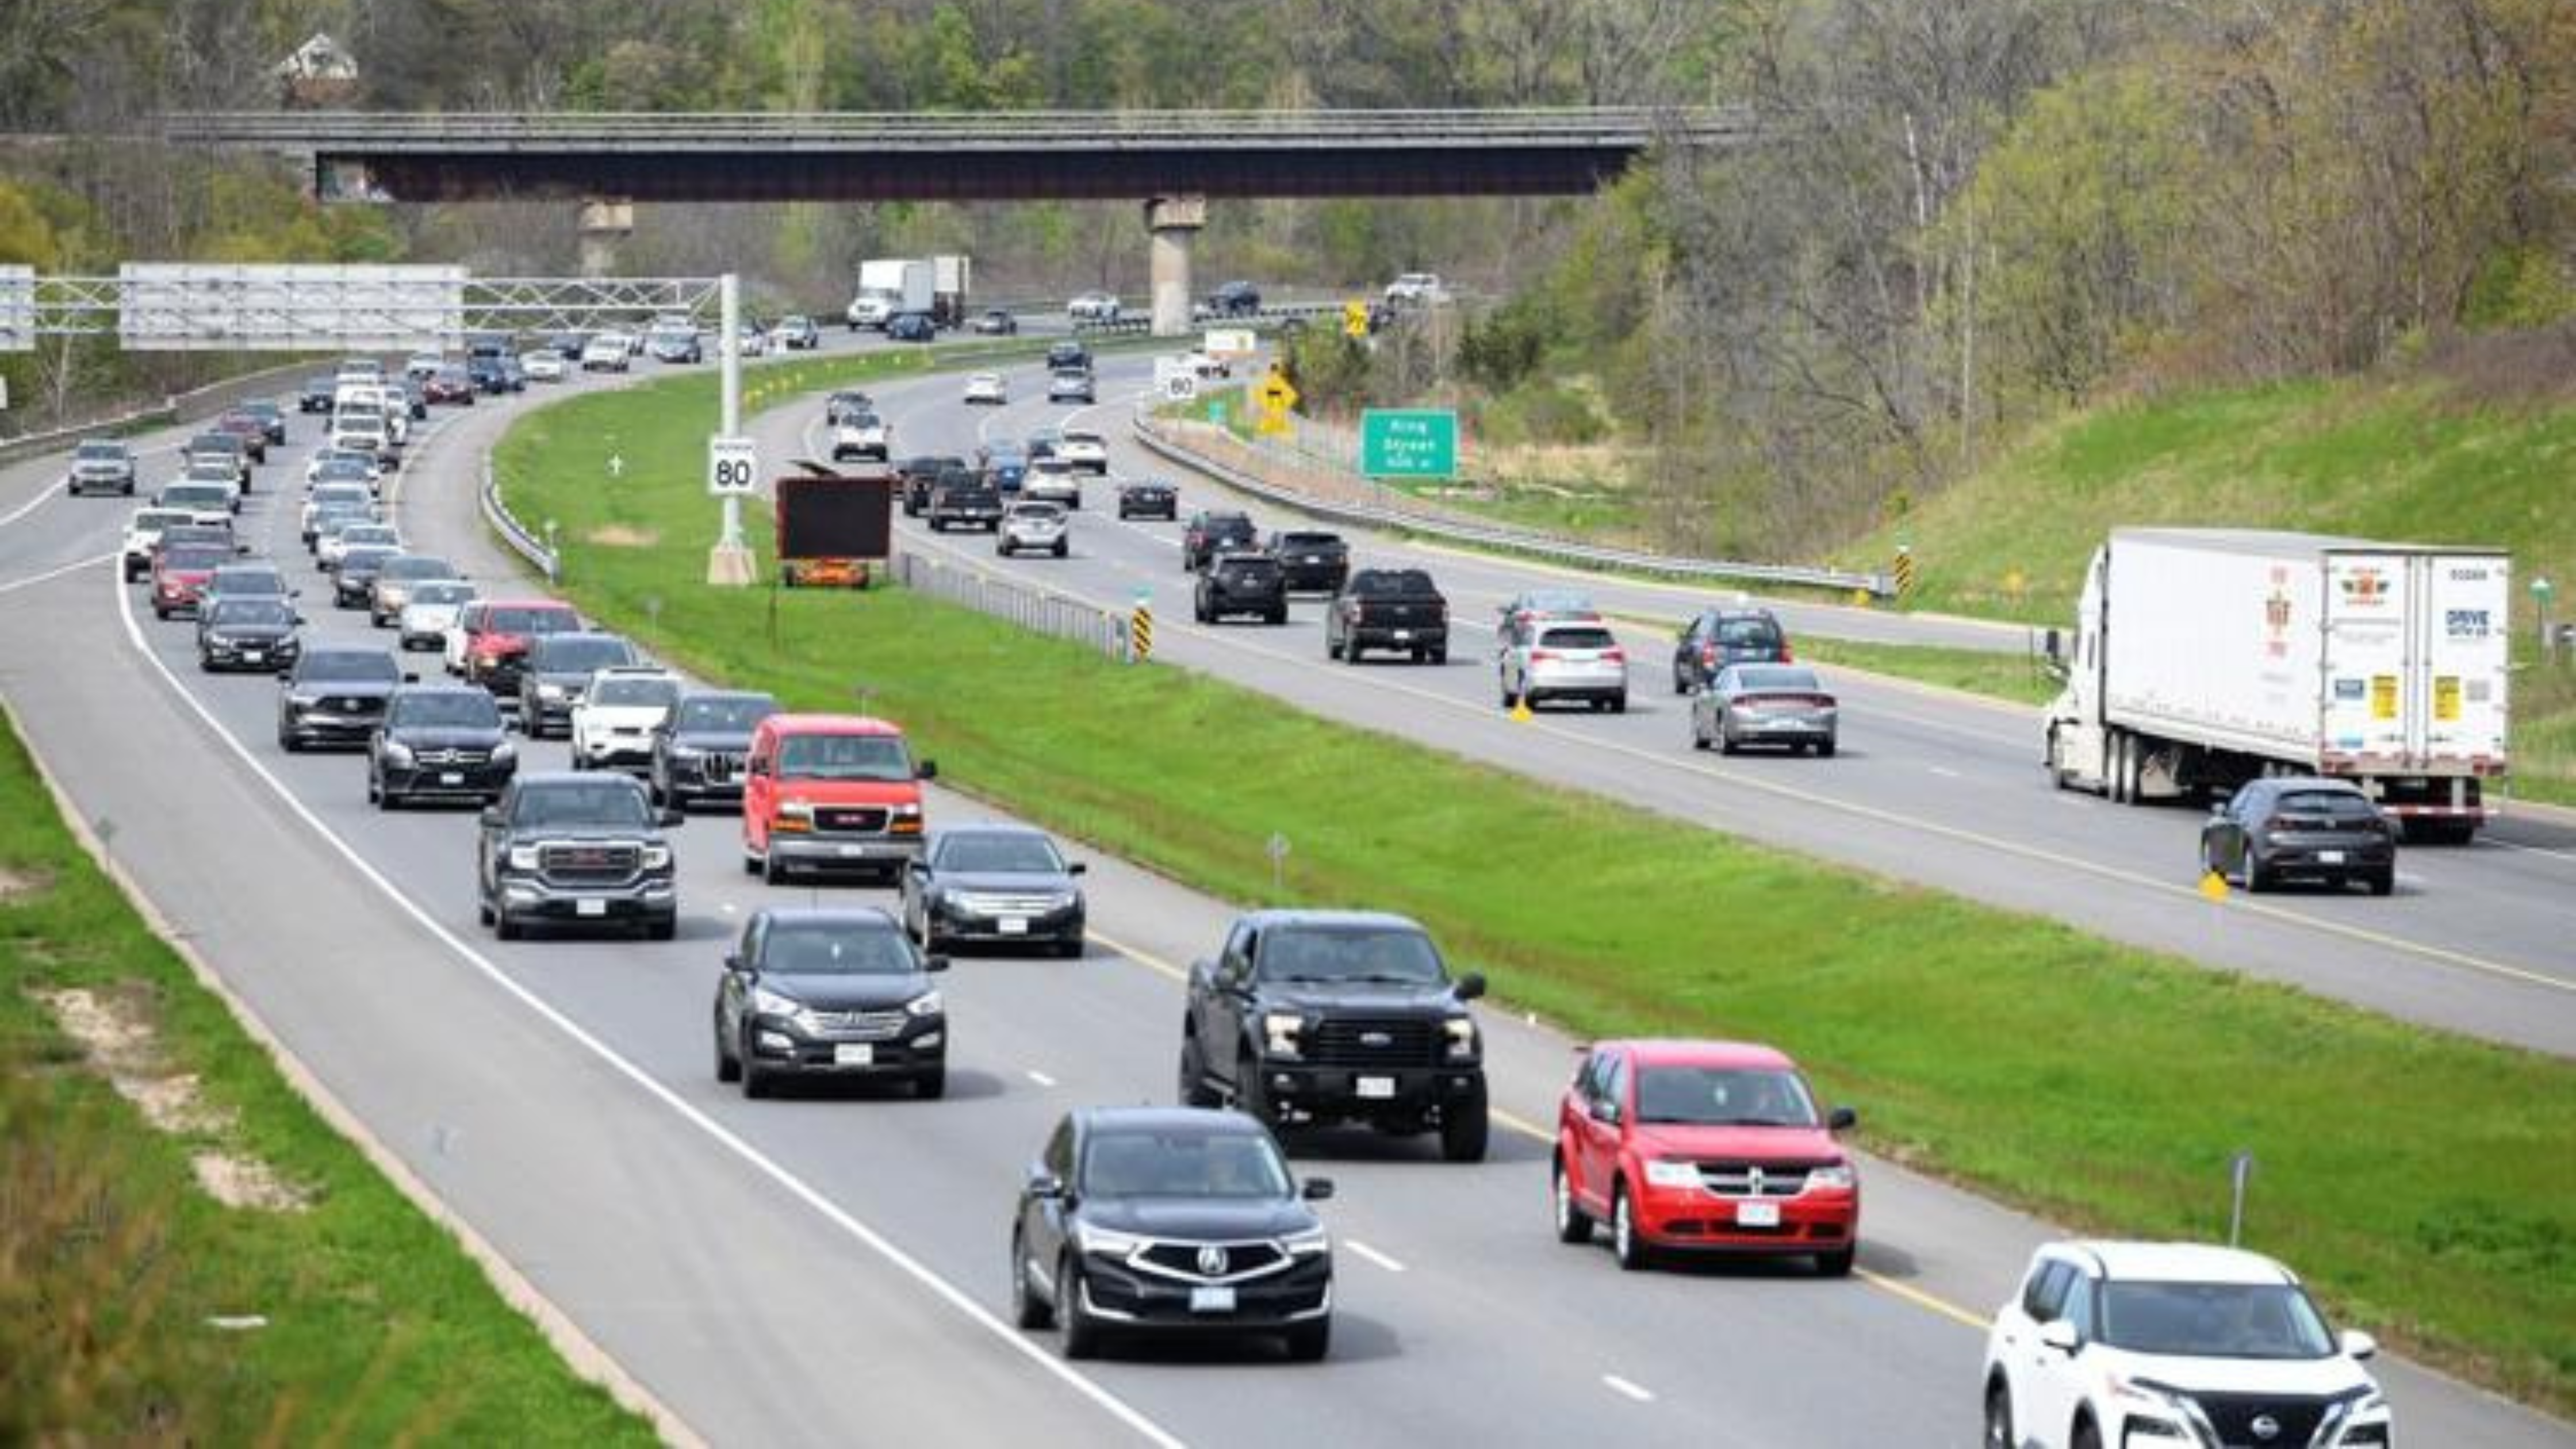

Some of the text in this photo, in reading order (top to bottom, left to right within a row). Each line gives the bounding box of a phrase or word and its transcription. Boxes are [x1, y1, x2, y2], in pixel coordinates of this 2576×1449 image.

[1383, 437, 1436, 451] Street
[716, 459, 750, 487] 80
[2447, 610, 2490, 625] DRIVE
